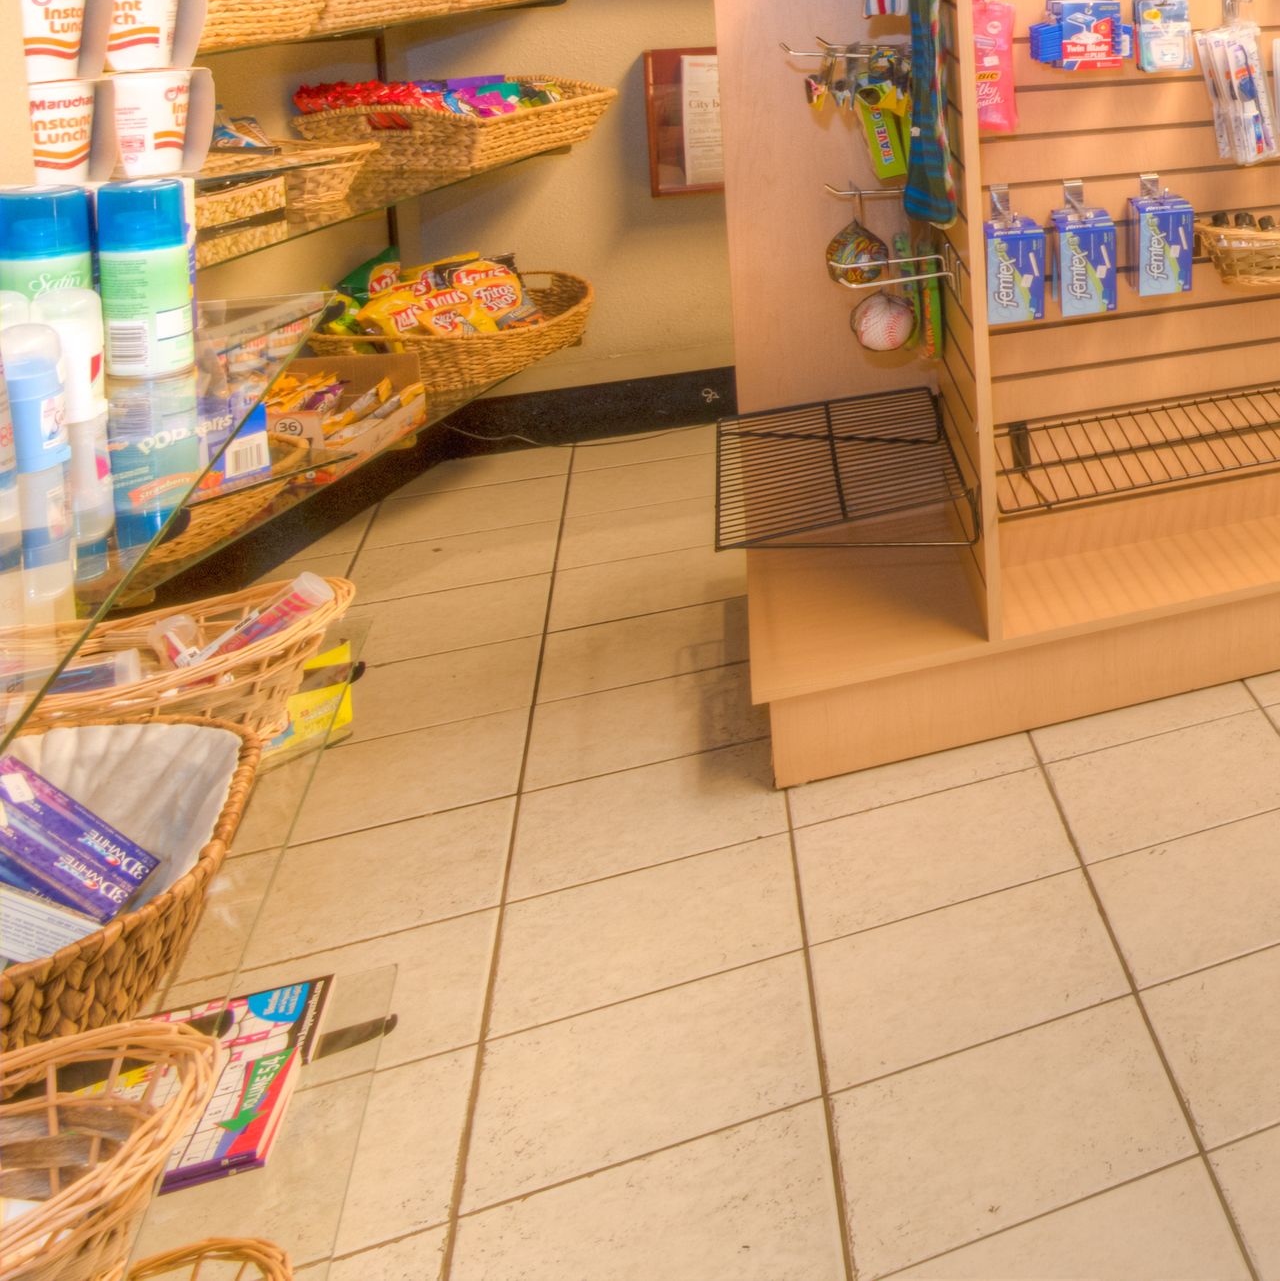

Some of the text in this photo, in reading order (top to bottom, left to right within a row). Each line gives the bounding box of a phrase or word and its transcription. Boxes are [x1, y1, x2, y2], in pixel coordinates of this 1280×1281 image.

[1066, 43, 1109, 52] Twin Blade
[688, 99, 709, 112] City
[33, 129, 89, 145] Lunch
[875, 122, 895, 165] TRAVEL
[1145, 231, 1168, 281] femtex
[993, 256, 1018, 309] femtex
[1068, 249, 1091, 300] femtex
[279, 421, 297, 433] 36
